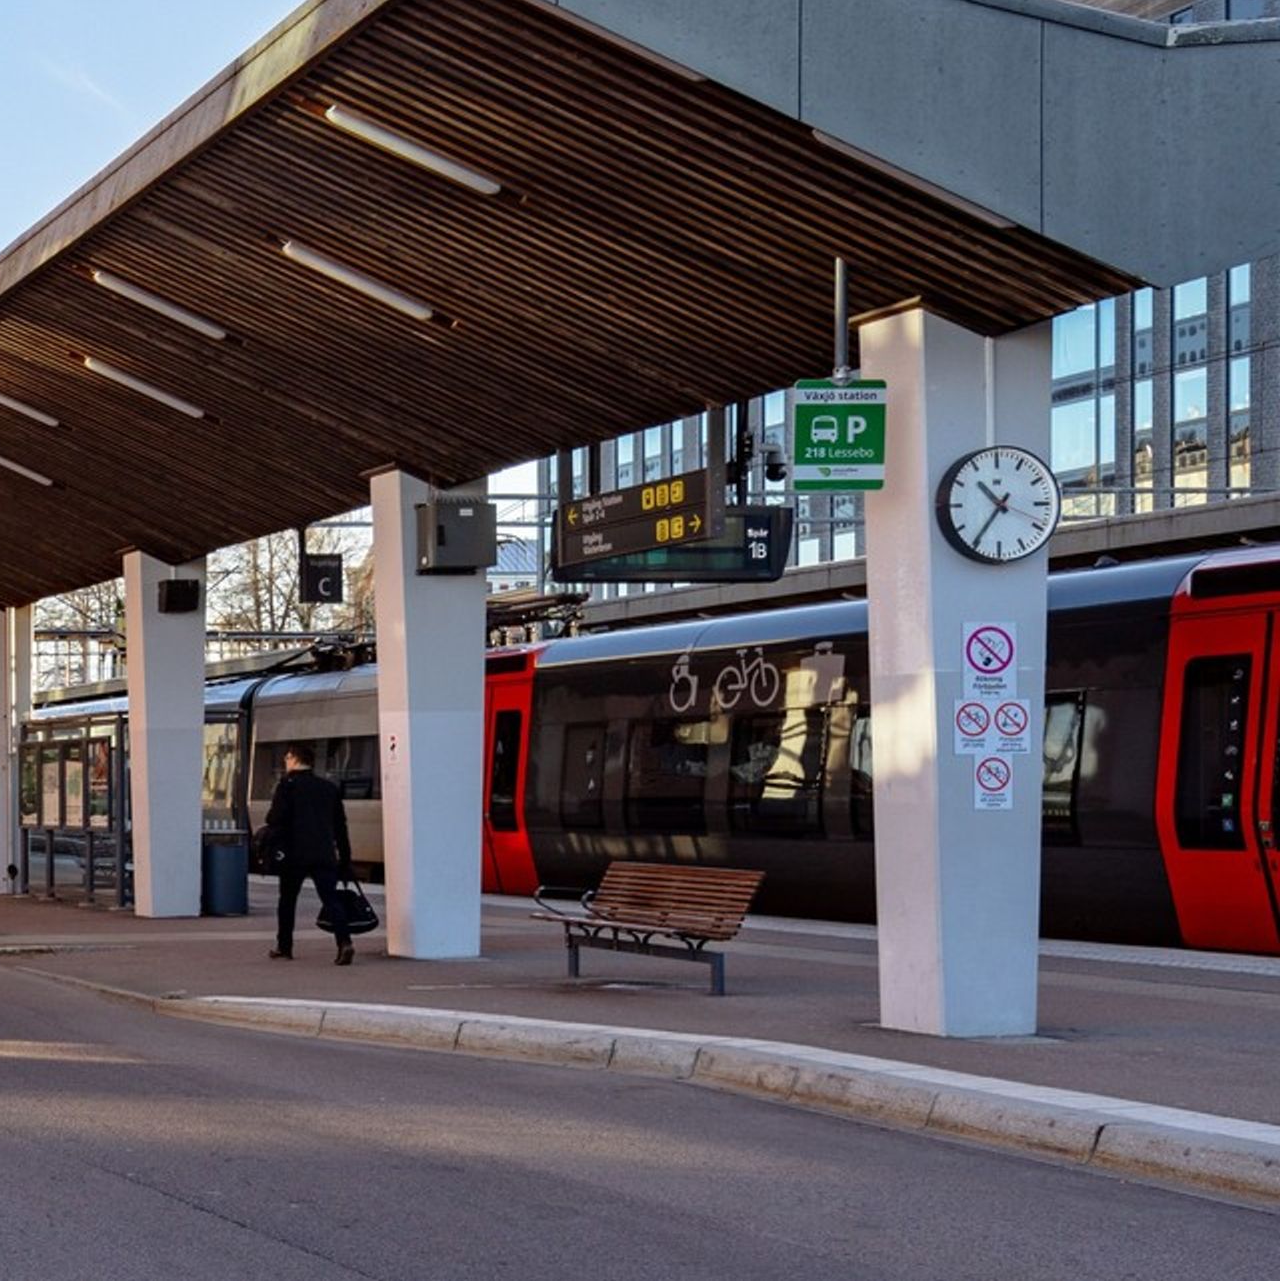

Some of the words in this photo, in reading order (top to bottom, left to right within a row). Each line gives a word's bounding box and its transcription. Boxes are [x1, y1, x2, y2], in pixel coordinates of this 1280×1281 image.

[804, 390, 836, 403] Växjö
[838, 391, 877, 400] station
[847, 415, 867, 444] P
[804, 447, 827, 458] 218
[828, 447, 875, 458] Lessebo
[318, 577, 331, 596] C
